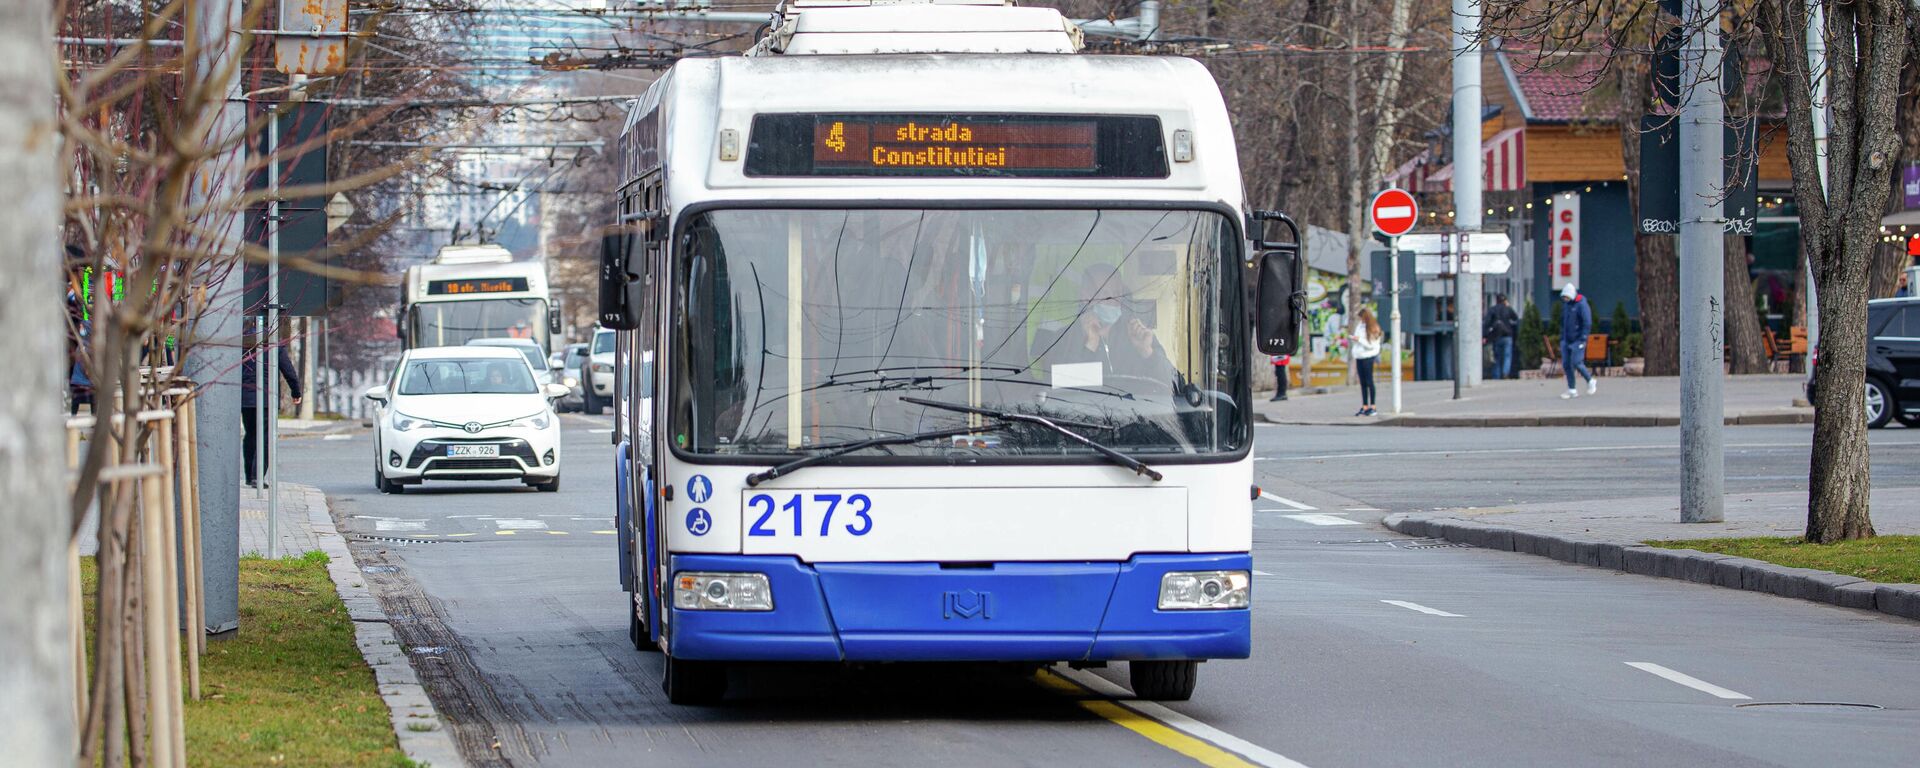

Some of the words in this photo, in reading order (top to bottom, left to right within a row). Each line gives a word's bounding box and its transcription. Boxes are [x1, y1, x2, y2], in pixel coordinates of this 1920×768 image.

[825, 122, 846, 152] 4
[896, 122, 972, 141] strada
[872, 146, 1005, 165] Constitutiei
[1560, 209, 1573, 276] CAFE
[1269, 338, 1285, 346] 173
[455, 446, 472, 455] ZZK
[478, 446, 495, 455] 926
[748, 494, 873, 536] 2173
